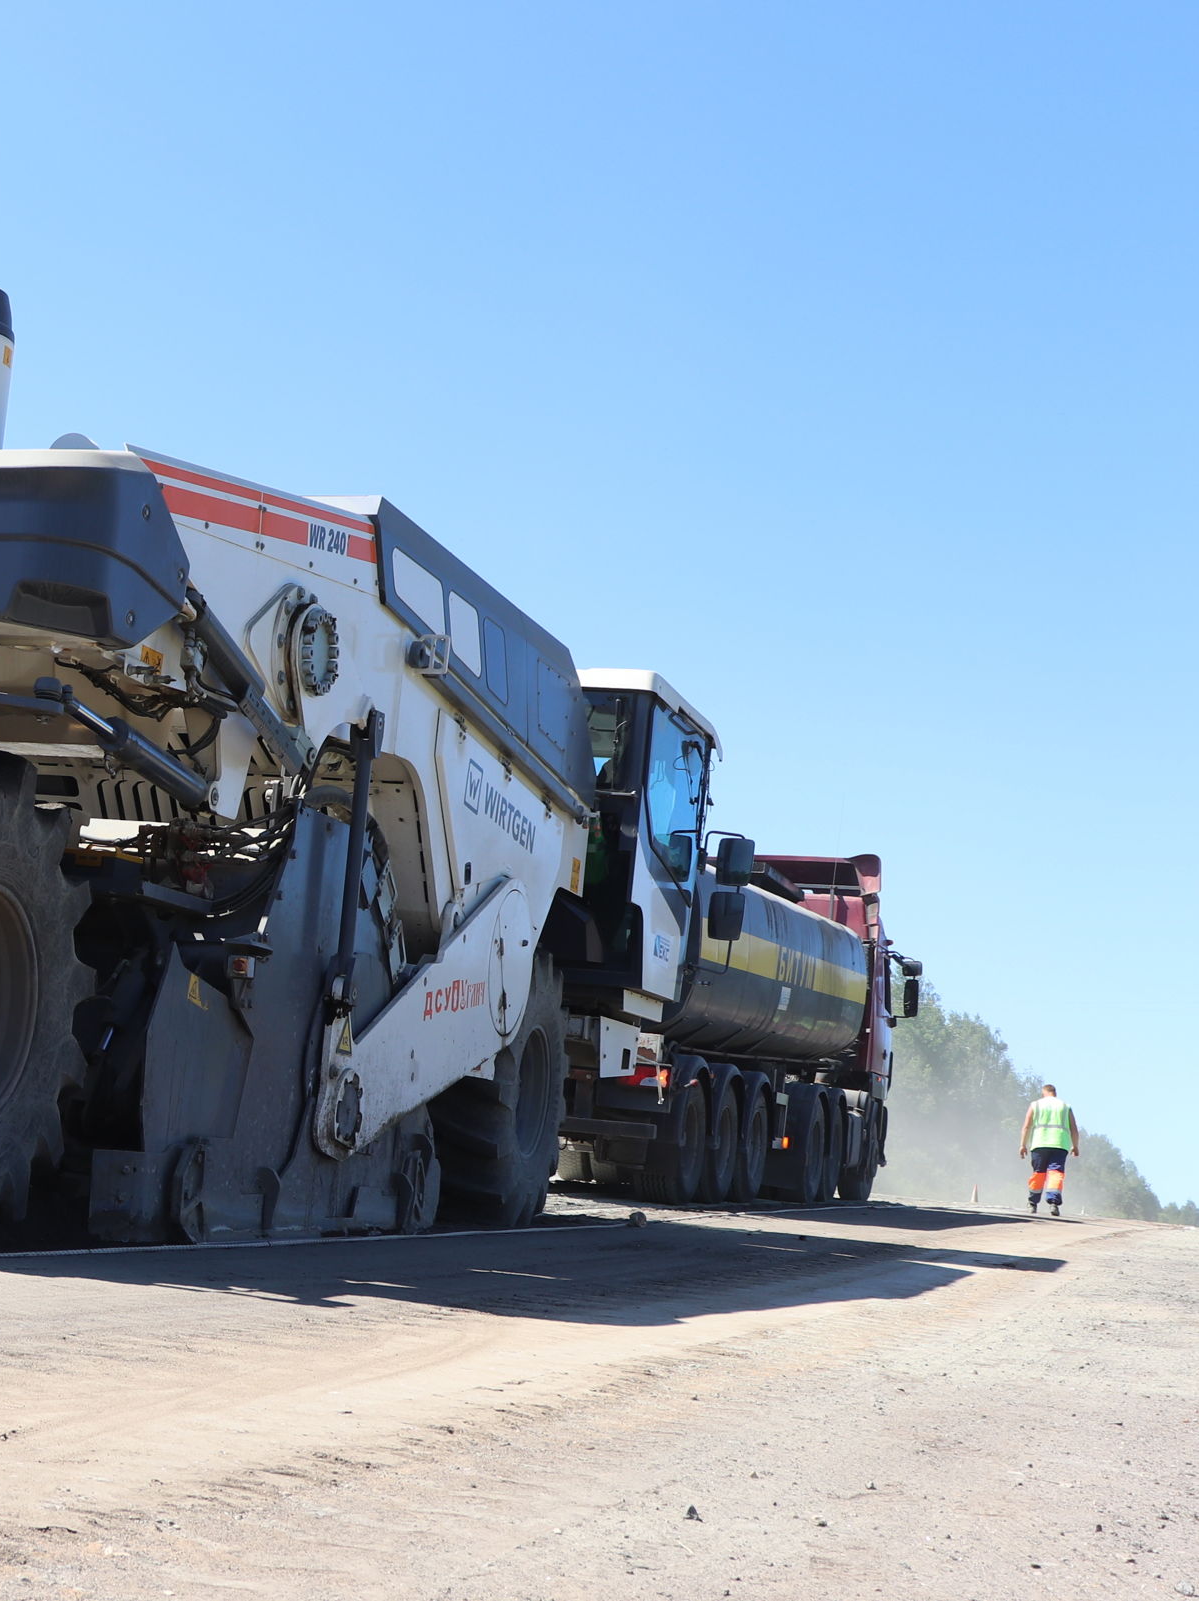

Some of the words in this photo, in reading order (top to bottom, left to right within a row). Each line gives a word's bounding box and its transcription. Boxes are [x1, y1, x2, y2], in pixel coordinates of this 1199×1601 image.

[309, 523, 327, 551] WR
[327, 528, 347, 556] 240
[484, 782, 536, 854] WIRTGEN
